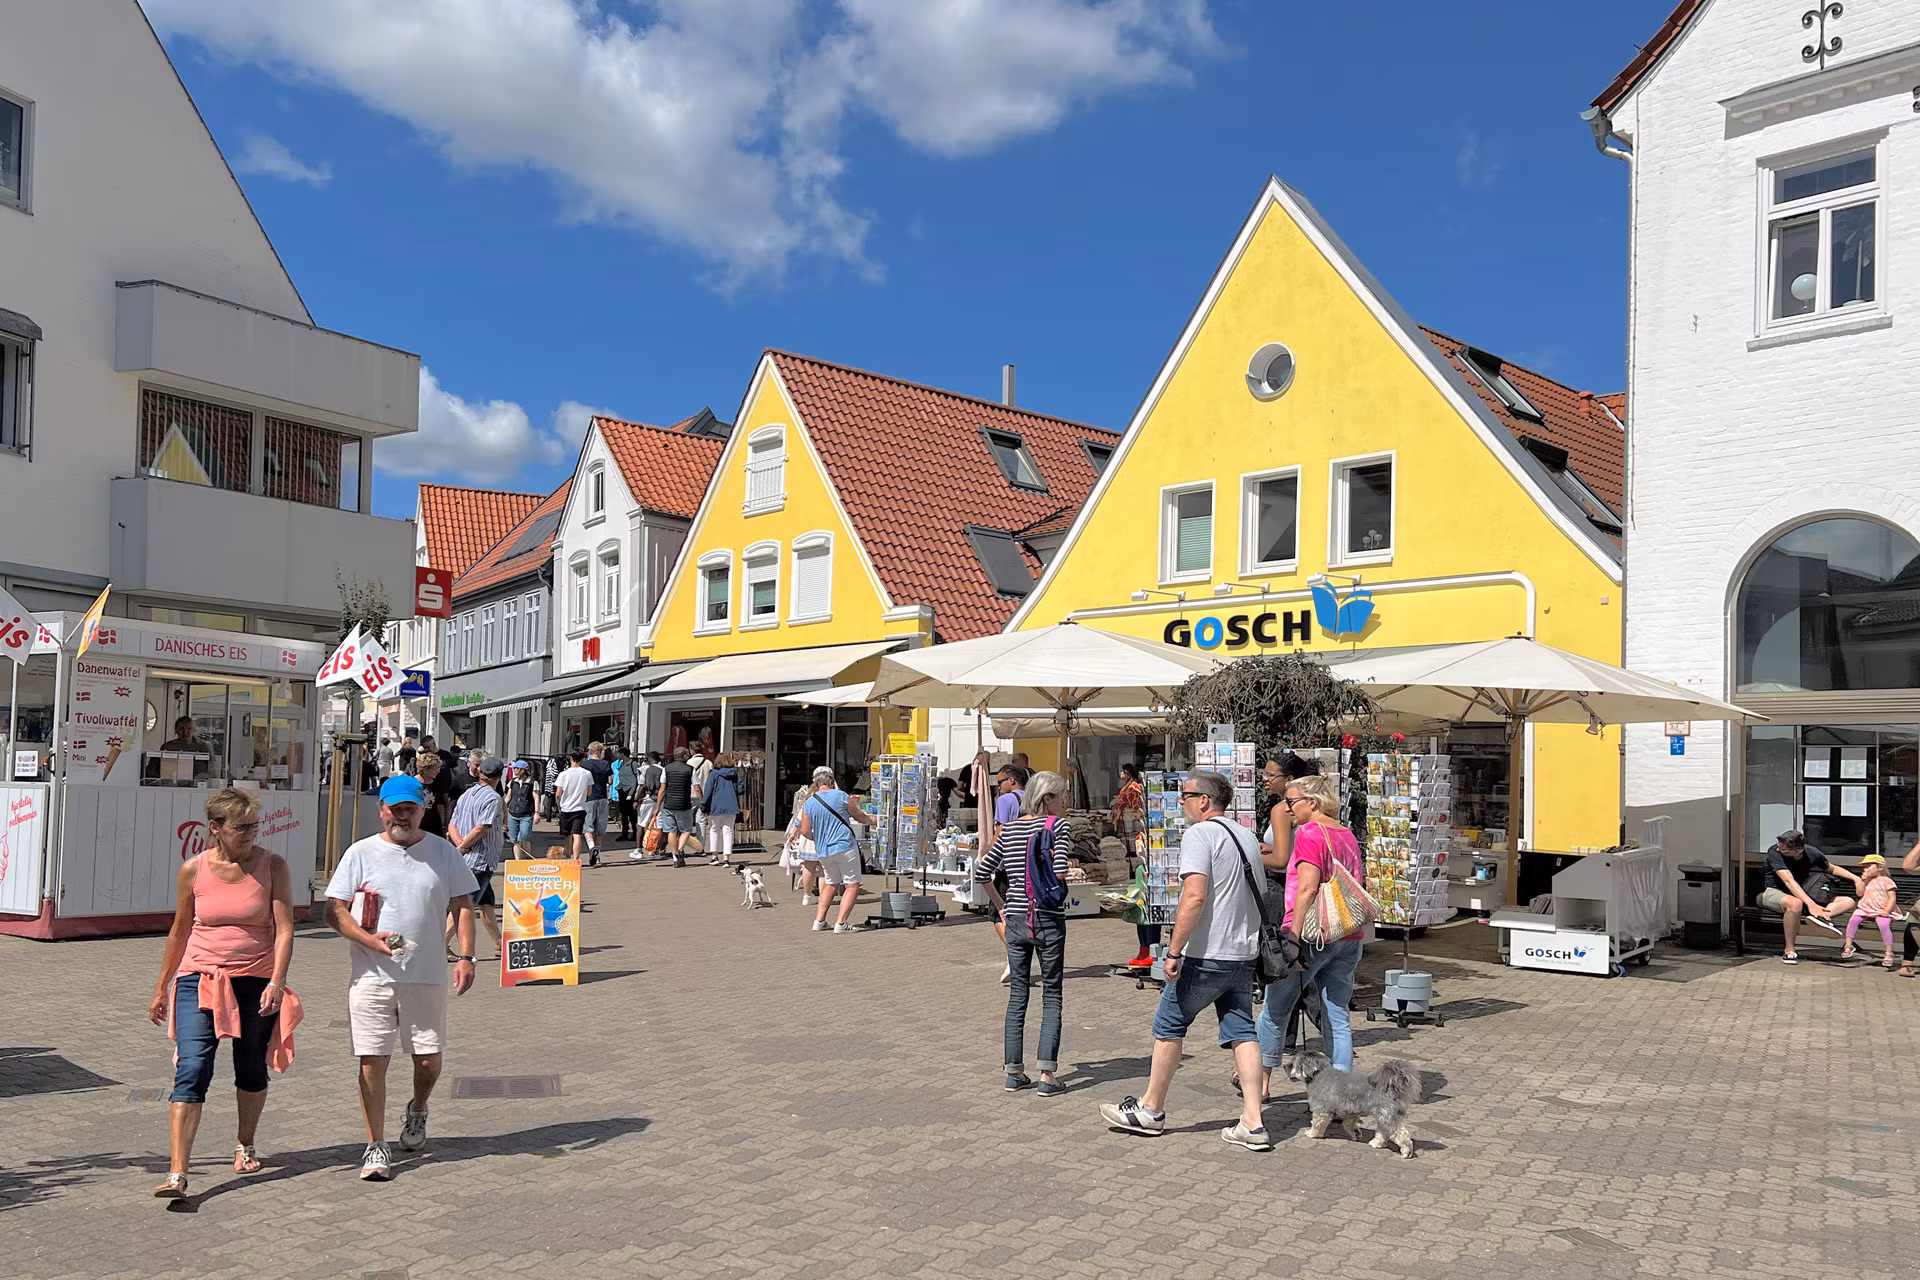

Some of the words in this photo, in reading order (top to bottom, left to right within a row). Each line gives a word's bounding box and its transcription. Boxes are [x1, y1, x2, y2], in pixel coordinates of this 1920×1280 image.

[1164, 610, 1311, 648] GOSCH
[155, 636, 225, 658] DÄNISCHES
[229, 646, 247, 661] EIS
[77, 662, 141, 678] Dänenwaffel
[75, 712, 138, 727] Tivoliwaffel
[515, 880, 577, 891] LECKER!
[1525, 947, 1572, 960] GOSCH
